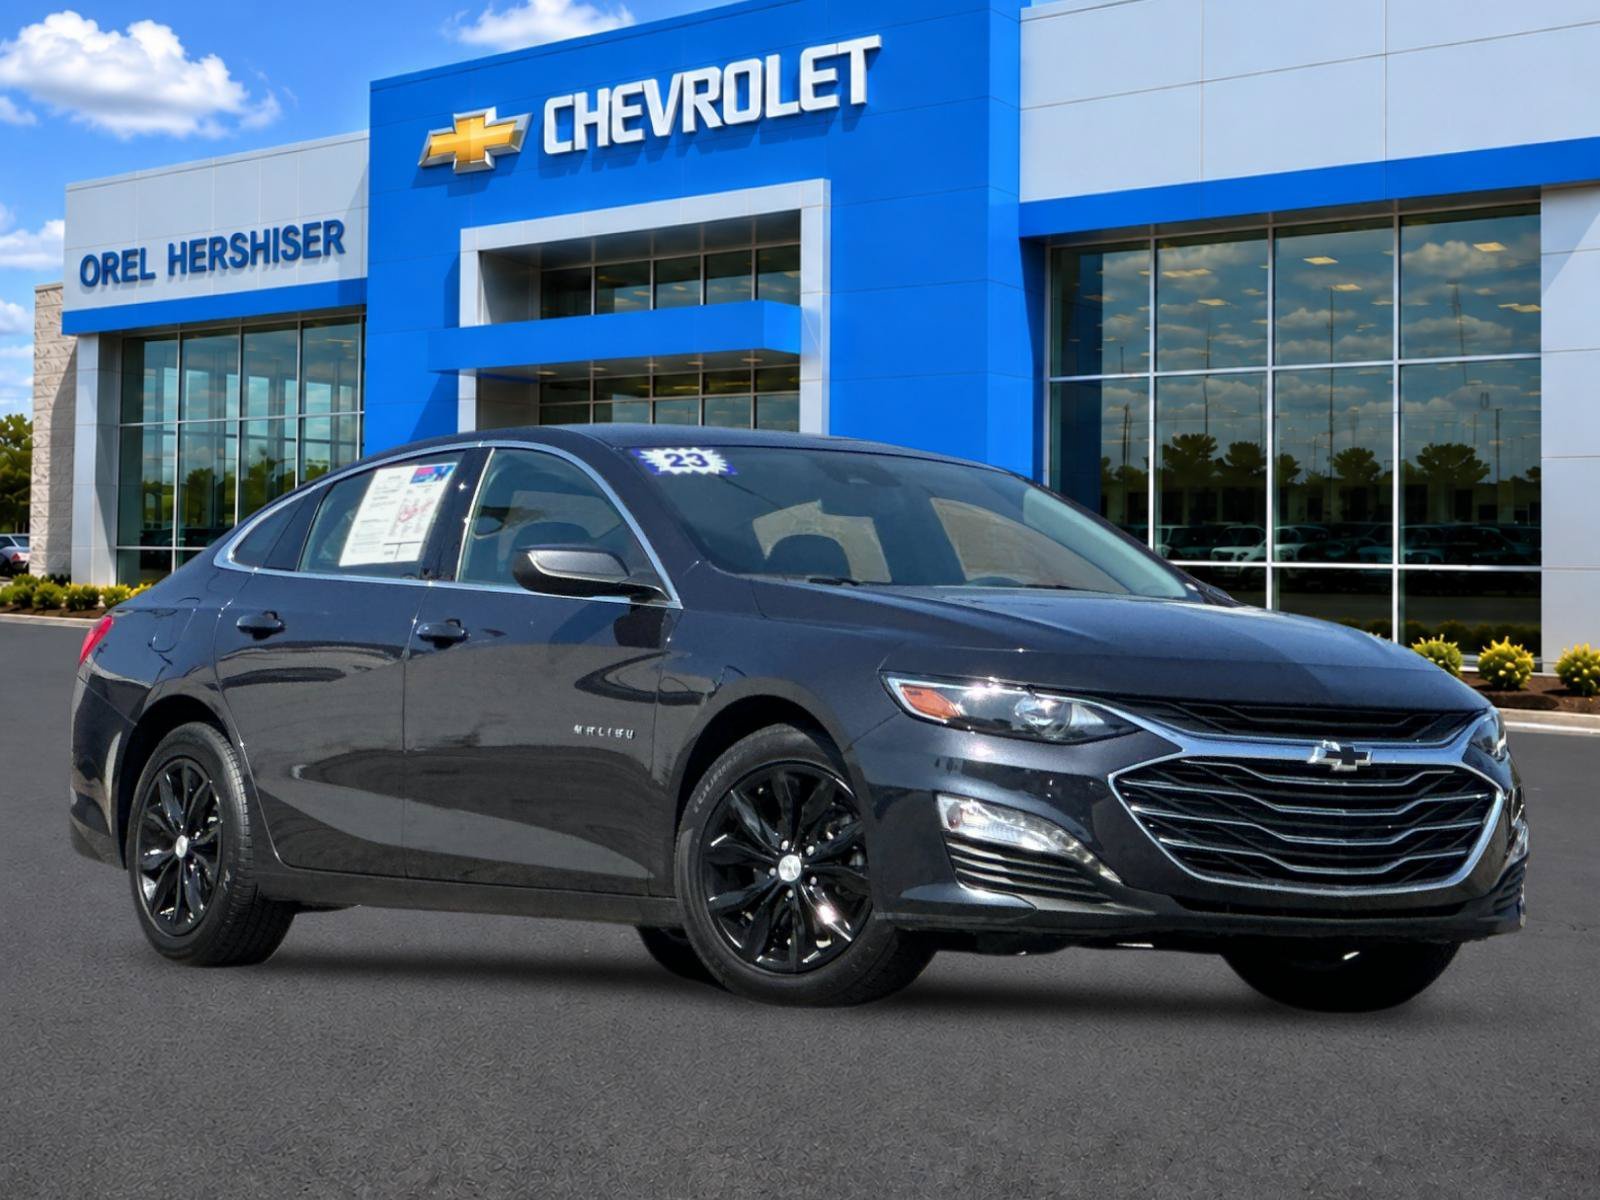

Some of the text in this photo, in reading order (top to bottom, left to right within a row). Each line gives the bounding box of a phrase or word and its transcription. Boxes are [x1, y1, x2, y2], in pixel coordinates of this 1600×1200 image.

[543, 34, 882, 155] CHEVROLET
[79, 219, 346, 288] OREL HERSHISER
[663, 453, 710, 468] 23
[573, 724, 634, 740] MALIBU
